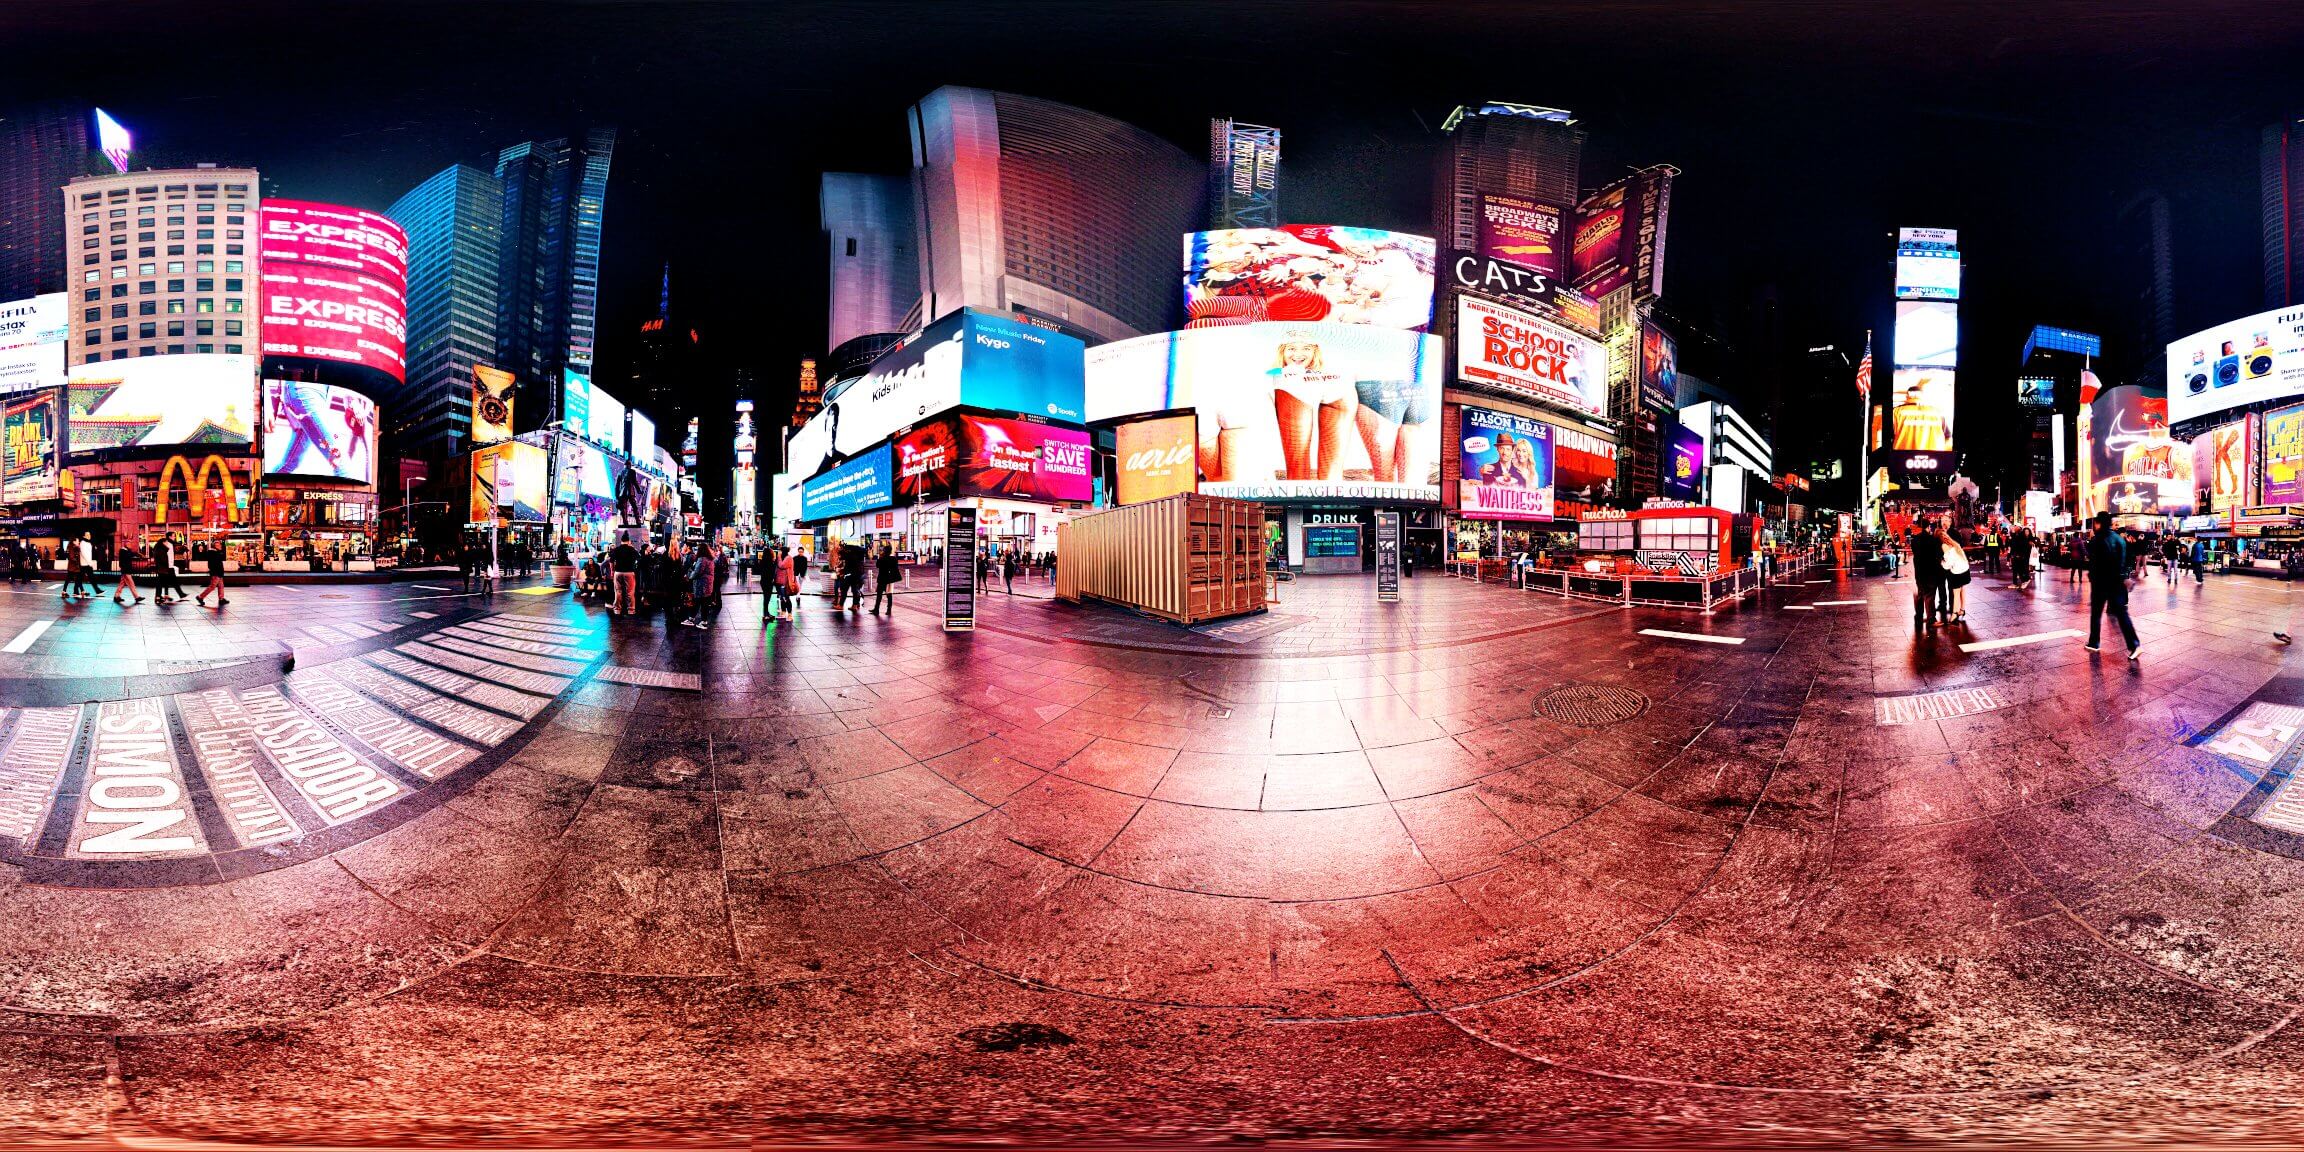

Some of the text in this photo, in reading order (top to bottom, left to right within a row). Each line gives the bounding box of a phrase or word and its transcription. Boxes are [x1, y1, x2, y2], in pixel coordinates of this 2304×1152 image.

[1485, 204, 1559, 222] BROADWAY'S
[1485, 210, 1559, 230] GOLDEN
[1485, 214, 1559, 234] TICKET
[269, 210, 408, 266] EXPRESS
[1576, 215, 1616, 245] CHARLIE
[1638, 216, 1656, 280] SQUARE
[1456, 256, 1548, 293] CATS
[1555, 286, 1593, 308] BROADWAY
[1570, 287, 1582, 297] ON
[271, 295, 406, 343] EXPRESS
[1467, 302, 1496, 315] ANDREW
[1497, 308, 1518, 321] LLOYD
[1519, 315, 1542, 330] WEBBER
[975, 323, 1047, 346] New Music Friday
[976, 333, 1011, 349] Kygo
[1483, 316, 1570, 359] SCHOOL
[2066, 333, 2098, 342] BARCLAYS
[1484, 335, 1569, 385] ROCK
[872, 383, 891, 403] Kids
[1057, 406, 1078, 419] Spotify
[1471, 412, 1547, 435] JASON MRAZ
[9, 423, 42, 447] BRONX
[1044, 439, 1087, 452] SWITCH NOW
[1556, 426, 1617, 461] BROADWAY'S
[13, 441, 39, 468] TALE
[903, 445, 945, 464] On the nation's
[990, 443, 1019, 458] On the
[1044, 446, 1086, 468] SAVE
[1126, 438, 1193, 472] aerie
[903, 455, 946, 477] fastest LTE
[989, 455, 1030, 473] fastest
[1044, 462, 1087, 476] HUNDREDS
[2127, 456, 2170, 479] BULLS
[303, 491, 344, 502] EXPRESS
[1201, 484, 1440, 502] AMERICAN EAGLE OUTFITTERS
[1476, 485, 1543, 512] WAITRESS
[1582, 507, 1627, 520] nuchas
[1642, 502, 1656, 510] NYC
[1667, 501, 1684, 509] DOGS
[1312, 514, 1358, 524] DRINK
[202, 690, 252, 727] CIRCLE
[74, 735, 88, 766] STREET
[2208, 720, 2301, 763] 54
[78, 713, 197, 853] SIMON
